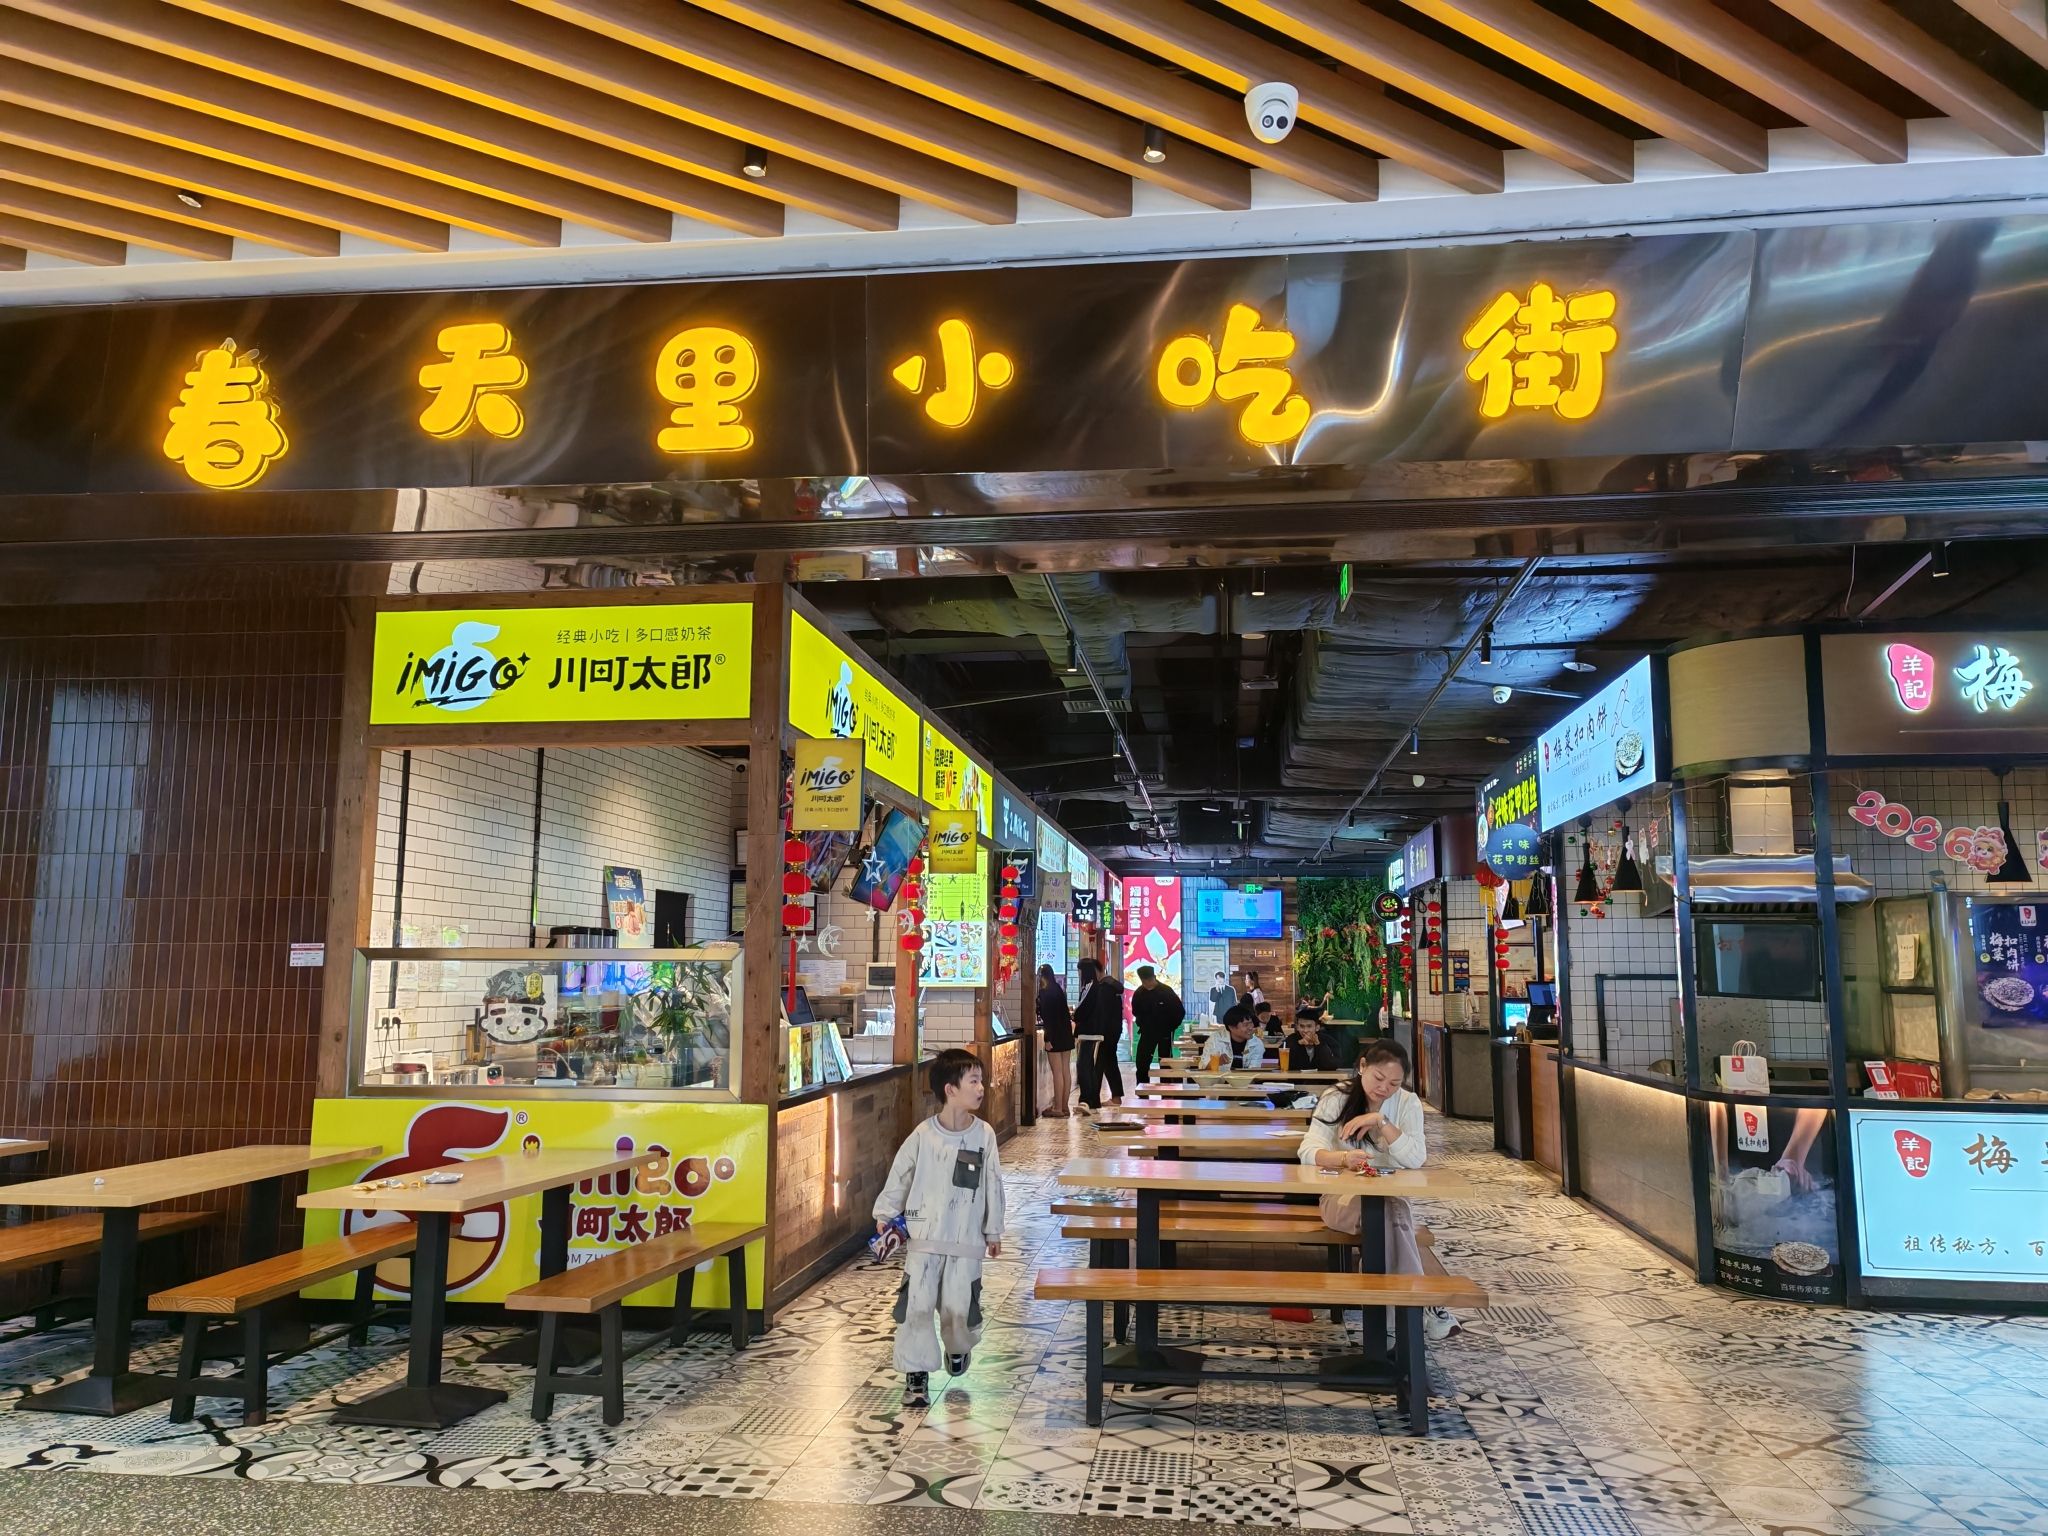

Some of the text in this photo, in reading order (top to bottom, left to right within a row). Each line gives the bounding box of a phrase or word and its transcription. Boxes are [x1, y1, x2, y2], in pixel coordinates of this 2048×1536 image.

[163, 283, 1620, 489] 春天里小吃街
[1953, 644, 2033, 713] 梅
[1553, 702, 1608, 763] 梅菜扣肉饼
[1492, 854, 1539, 865] 花甲粉丝
[1502, 839, 1530, 850] 兴味
[1901, 1137, 1928, 1171] 羊記
